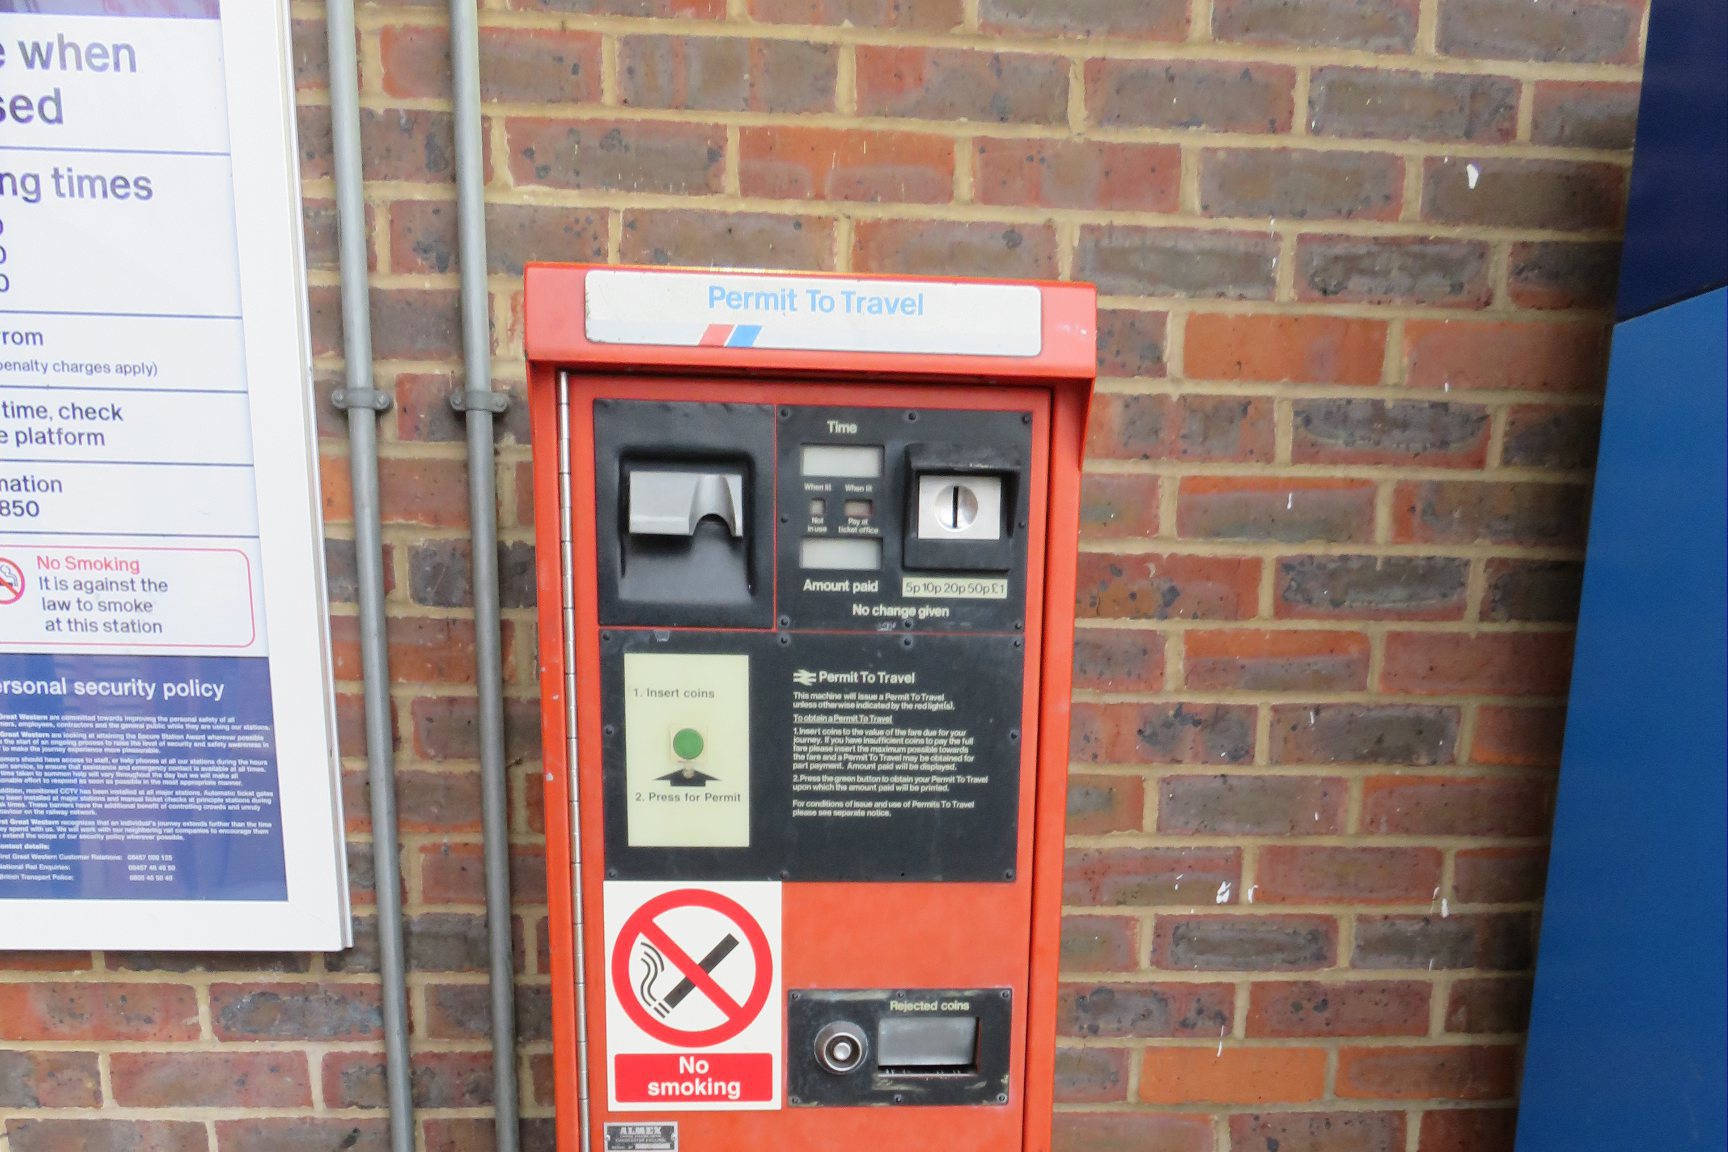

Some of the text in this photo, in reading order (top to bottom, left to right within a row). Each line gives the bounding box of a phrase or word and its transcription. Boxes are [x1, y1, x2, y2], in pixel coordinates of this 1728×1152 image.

[18, 32, 136, 72] when
[0, 87, 63, 124] ed
[51, 167, 153, 200] times
[708, 286, 924, 316] Permit To Travel
[0, 330, 44, 346] rom
[53, 360, 111, 375] charges
[115, 361, 158, 377] apply)
[2, 400, 123, 422] time, check
[827, 420, 858, 434] Time
[15, 427, 105, 448] platform
[804, 482, 824, 491] When
[845, 484, 864, 492] When
[848, 518, 860, 526] Pay
[859, 526, 879, 534] office
[37, 555, 140, 575] No Smoking
[39, 576, 168, 594] It is against the
[803, 578, 878, 594] Amount paid
[906, 582, 920, 594] 5p
[923, 582, 941, 594] 10p
[944, 582, 965, 595] 20p
[968, 583, 989, 596] 50p
[42, 597, 152, 612] law to smoke
[852, 604, 950, 620] No change given
[45, 617, 162, 633] at this station
[819, 671, 915, 684] Permit To Travel
[0, 677, 224, 701] rsonal security policy
[634, 688, 715, 698] 1. Insert coins
[793, 692, 809, 700] This
[810, 692, 842, 700] machine
[844, 692, 856, 700] will
[885, 693, 909, 701] Permit
[910, 693, 920, 701] To
[921, 693, 944, 701] Travel
[793, 714, 803, 722] To
[804, 714, 827, 722] obtain
[834, 714, 858, 723] Permit
[859, 714, 868, 723] To
[869, 714, 892, 723] Travel
[864, 728, 884, 736] value
[885, 728, 893, 736] of
[895, 728, 907, 736] the
[908, 728, 922, 736] fare
[831, 737, 844, 745] you
[845, 736, 862, 744] have
[905, 736, 924, 744] coins
[934, 738, 948, 746] pay
[949, 737, 960, 745] the
[962, 737, 974, 745] full
[834, 776, 855, 784] green
[882, 775, 889, 783] to
[890, 775, 913, 783] obtain
[878, 784, 894, 792] paid
[636, 792, 741, 802] 2. Press for Permit
[845, 800, 853, 808] of
[874, 800, 888, 808] and
[903, 800, 911, 808] of
[912, 800, 940, 808] Permits
[941, 800, 951, 808] To
[952, 800, 974, 808] Travel
[792, 809, 817, 817] please
[833, 809, 865, 817] separate
[890, 1000, 970, 1012] Rejected coins
[679, 1056, 709, 1074] No
[648, 1078, 740, 1100] smoking
[620, 1126, 662, 1134] ALMEX
